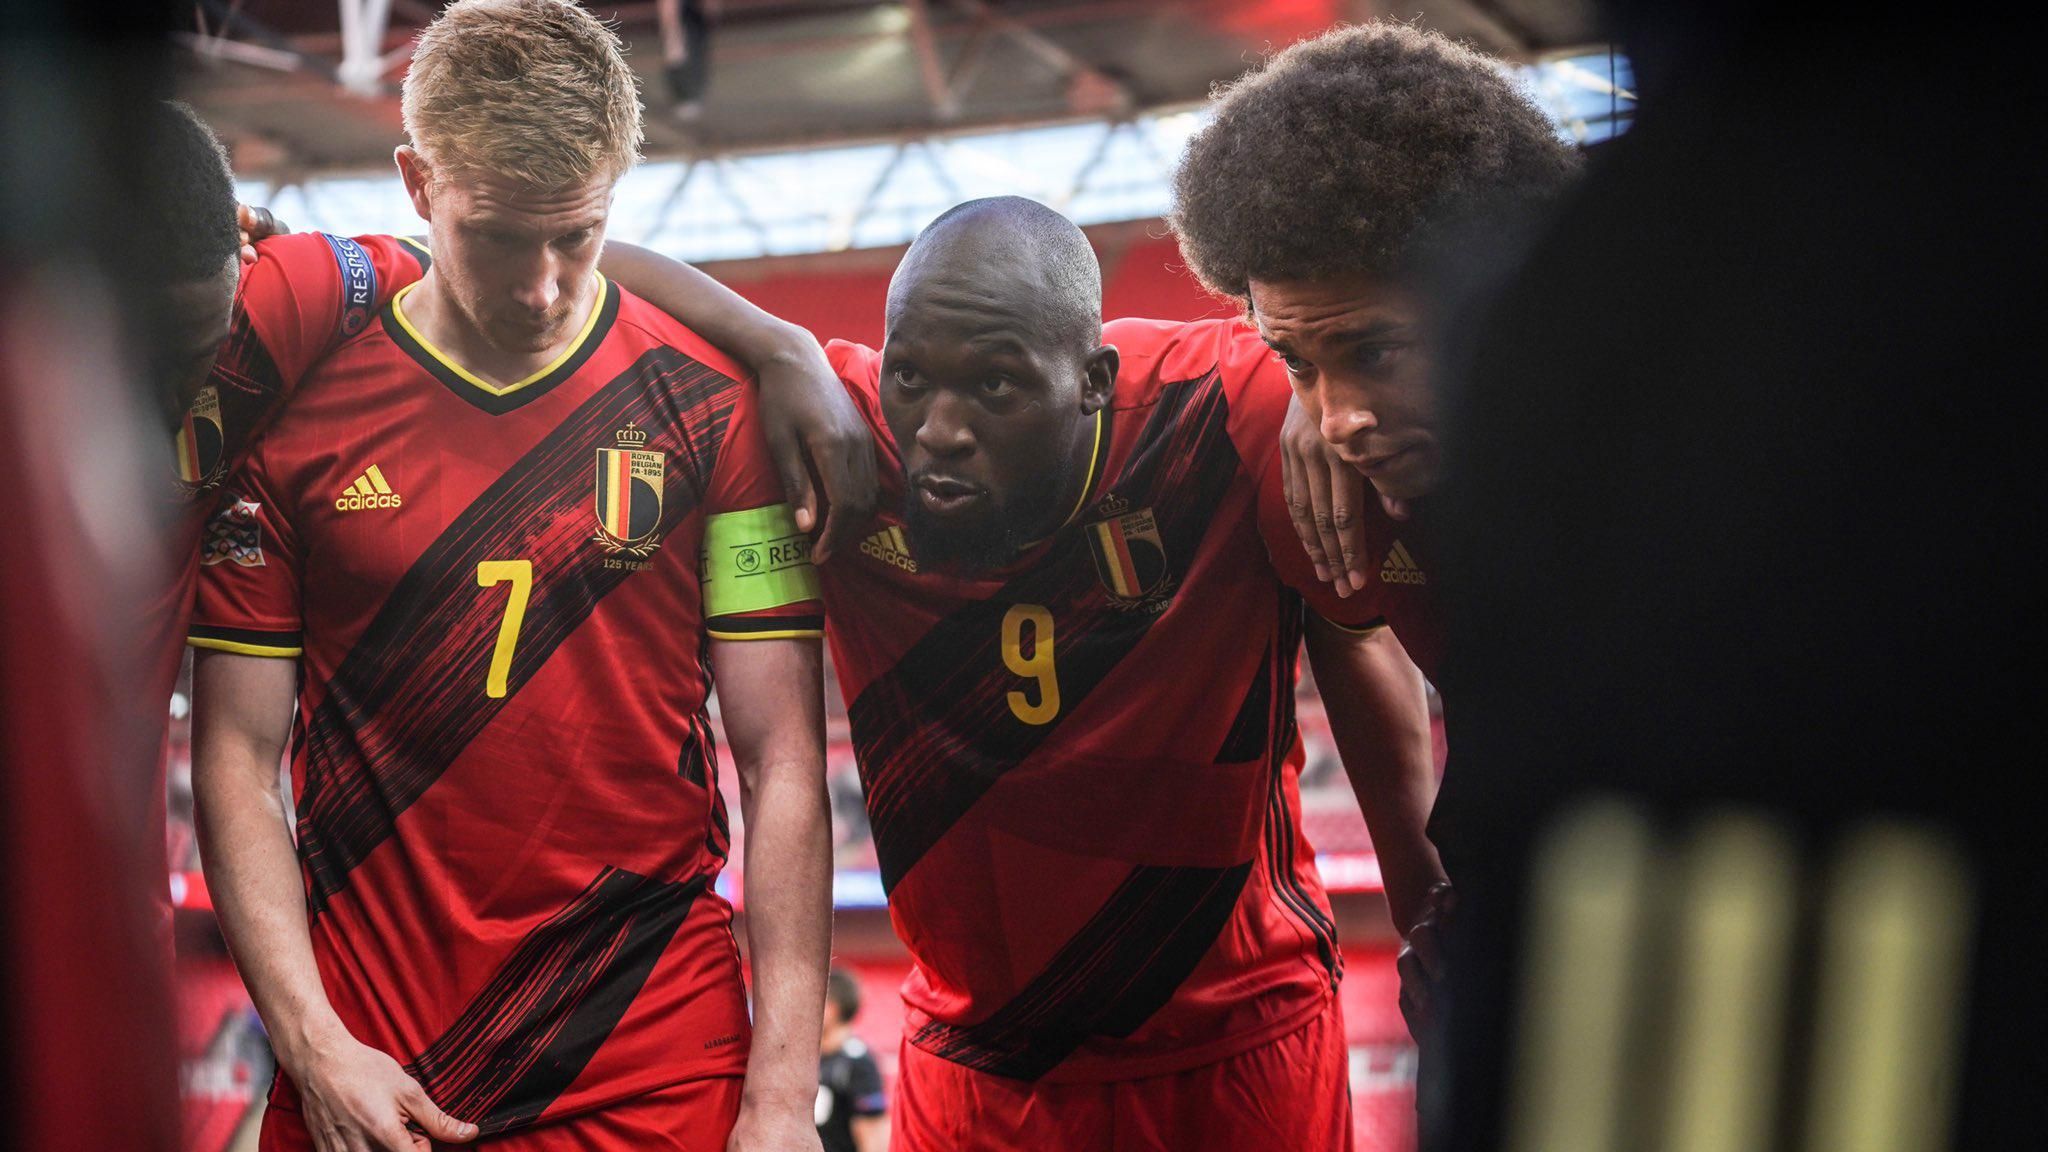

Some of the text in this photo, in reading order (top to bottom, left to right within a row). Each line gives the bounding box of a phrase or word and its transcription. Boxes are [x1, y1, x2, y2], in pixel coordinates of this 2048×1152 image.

[331, 235, 368, 303] RESPECT
[631, 453, 655, 461] ROYAL
[631, 461, 662, 469] BELGIAN
[335, 493, 402, 511] adidas
[603, 558, 655, 571] 125 YEARS
[859, 541, 918, 573] adidas
[1380, 568, 1425, 585] adidas
[477, 559, 533, 698] 7
[1001, 604, 1061, 725] 9
